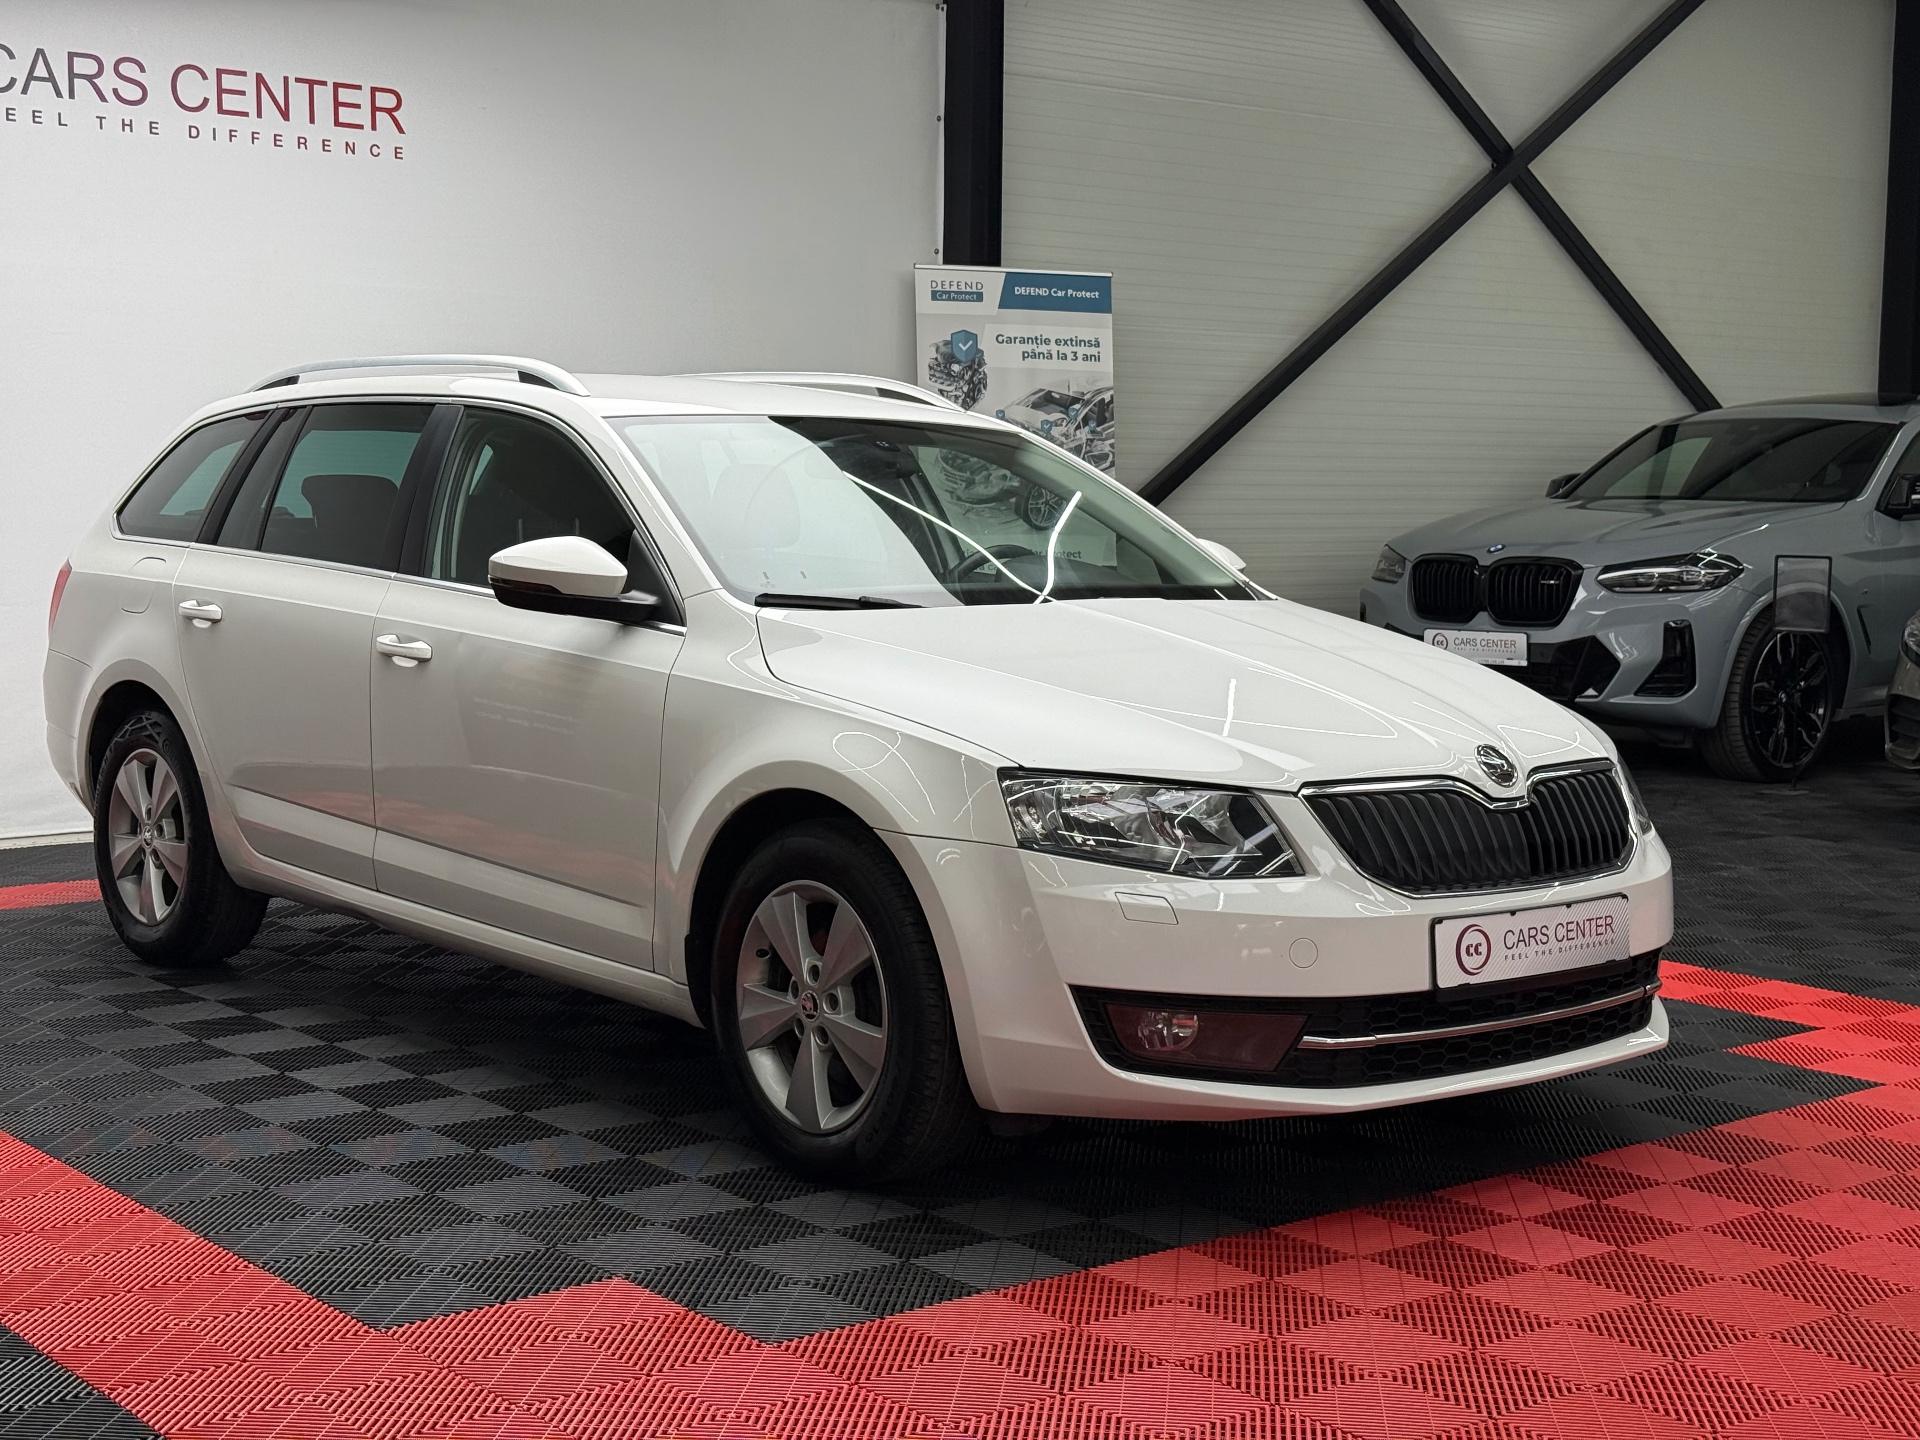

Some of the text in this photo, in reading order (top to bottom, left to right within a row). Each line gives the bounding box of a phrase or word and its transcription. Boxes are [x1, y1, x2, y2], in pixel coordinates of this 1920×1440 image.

[171, 64, 406, 134] CENTER
[5, 107, 404, 160] EEL THE DIFFERENCE
[930, 280, 984, 291] DEFEND
[936, 291, 977, 301] Car Protect
[1014, 287, 1100, 299] DEFEND Car Protect
[995, 334, 1101, 348] Garanție extinsă
[1021, 349, 1101, 362] până la 3 ani
[1453, 637, 1516, 649] CARS CENTER
[1503, 915, 1615, 950] CARS CENTER
[1504, 952, 1529, 961] FEEL
[1535, 948, 1553, 957] THE
